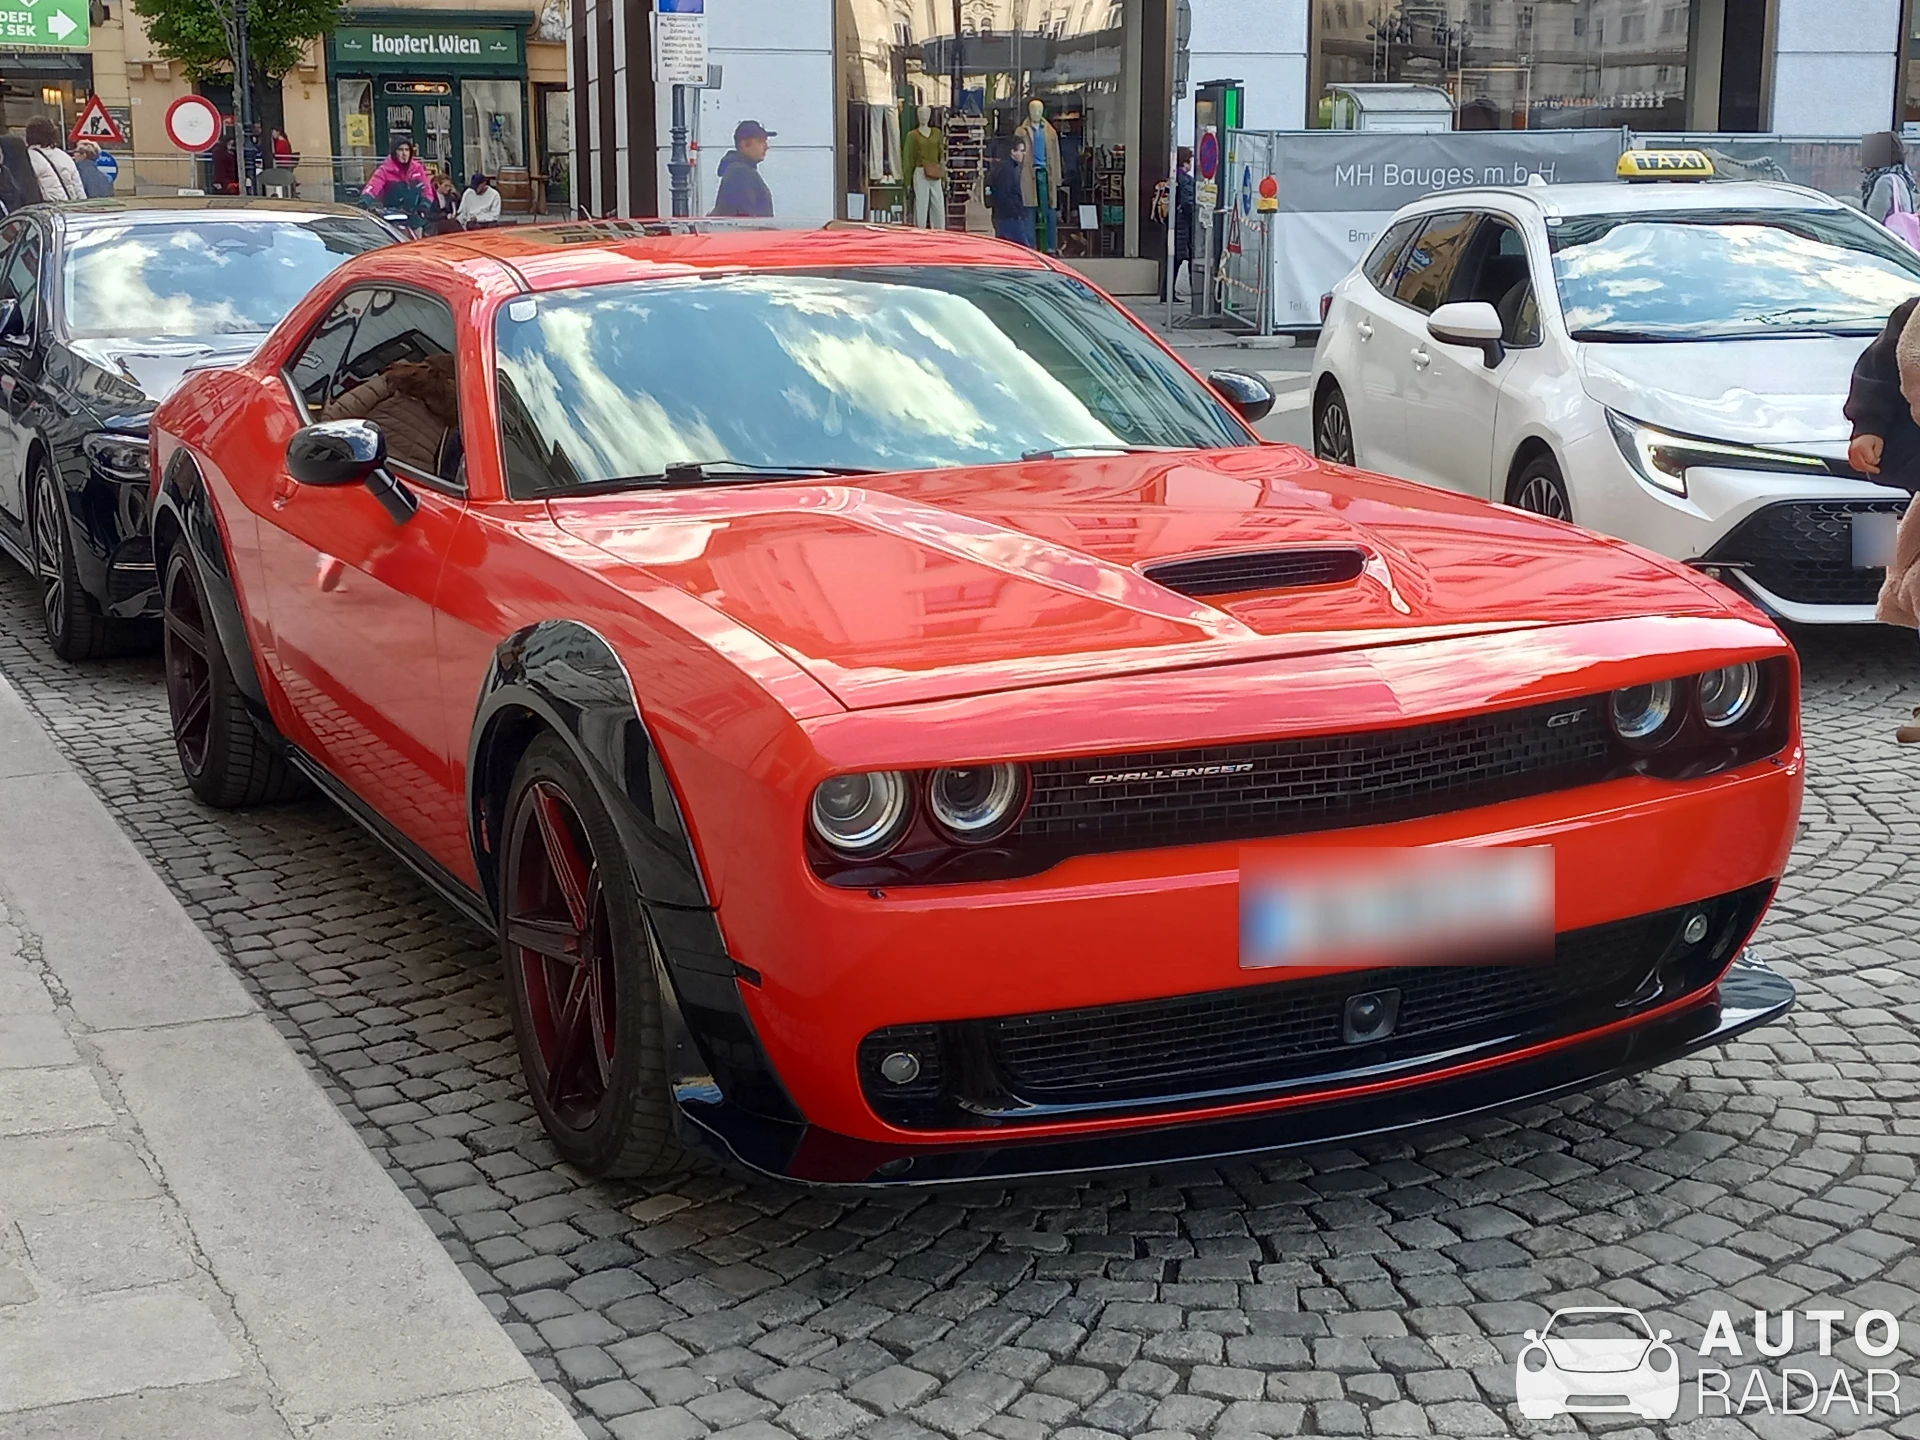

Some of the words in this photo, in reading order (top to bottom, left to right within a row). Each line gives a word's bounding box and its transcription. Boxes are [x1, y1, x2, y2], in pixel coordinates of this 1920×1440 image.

[0, 11, 32, 24] DEFI
[7, 24, 37, 37] SEK
[1633, 152, 1704, 169] TAXI
[1335, 164, 1374, 187] MH
[1547, 708, 1588, 728] GT
[1088, 763, 1254, 785] CHALLENGER
